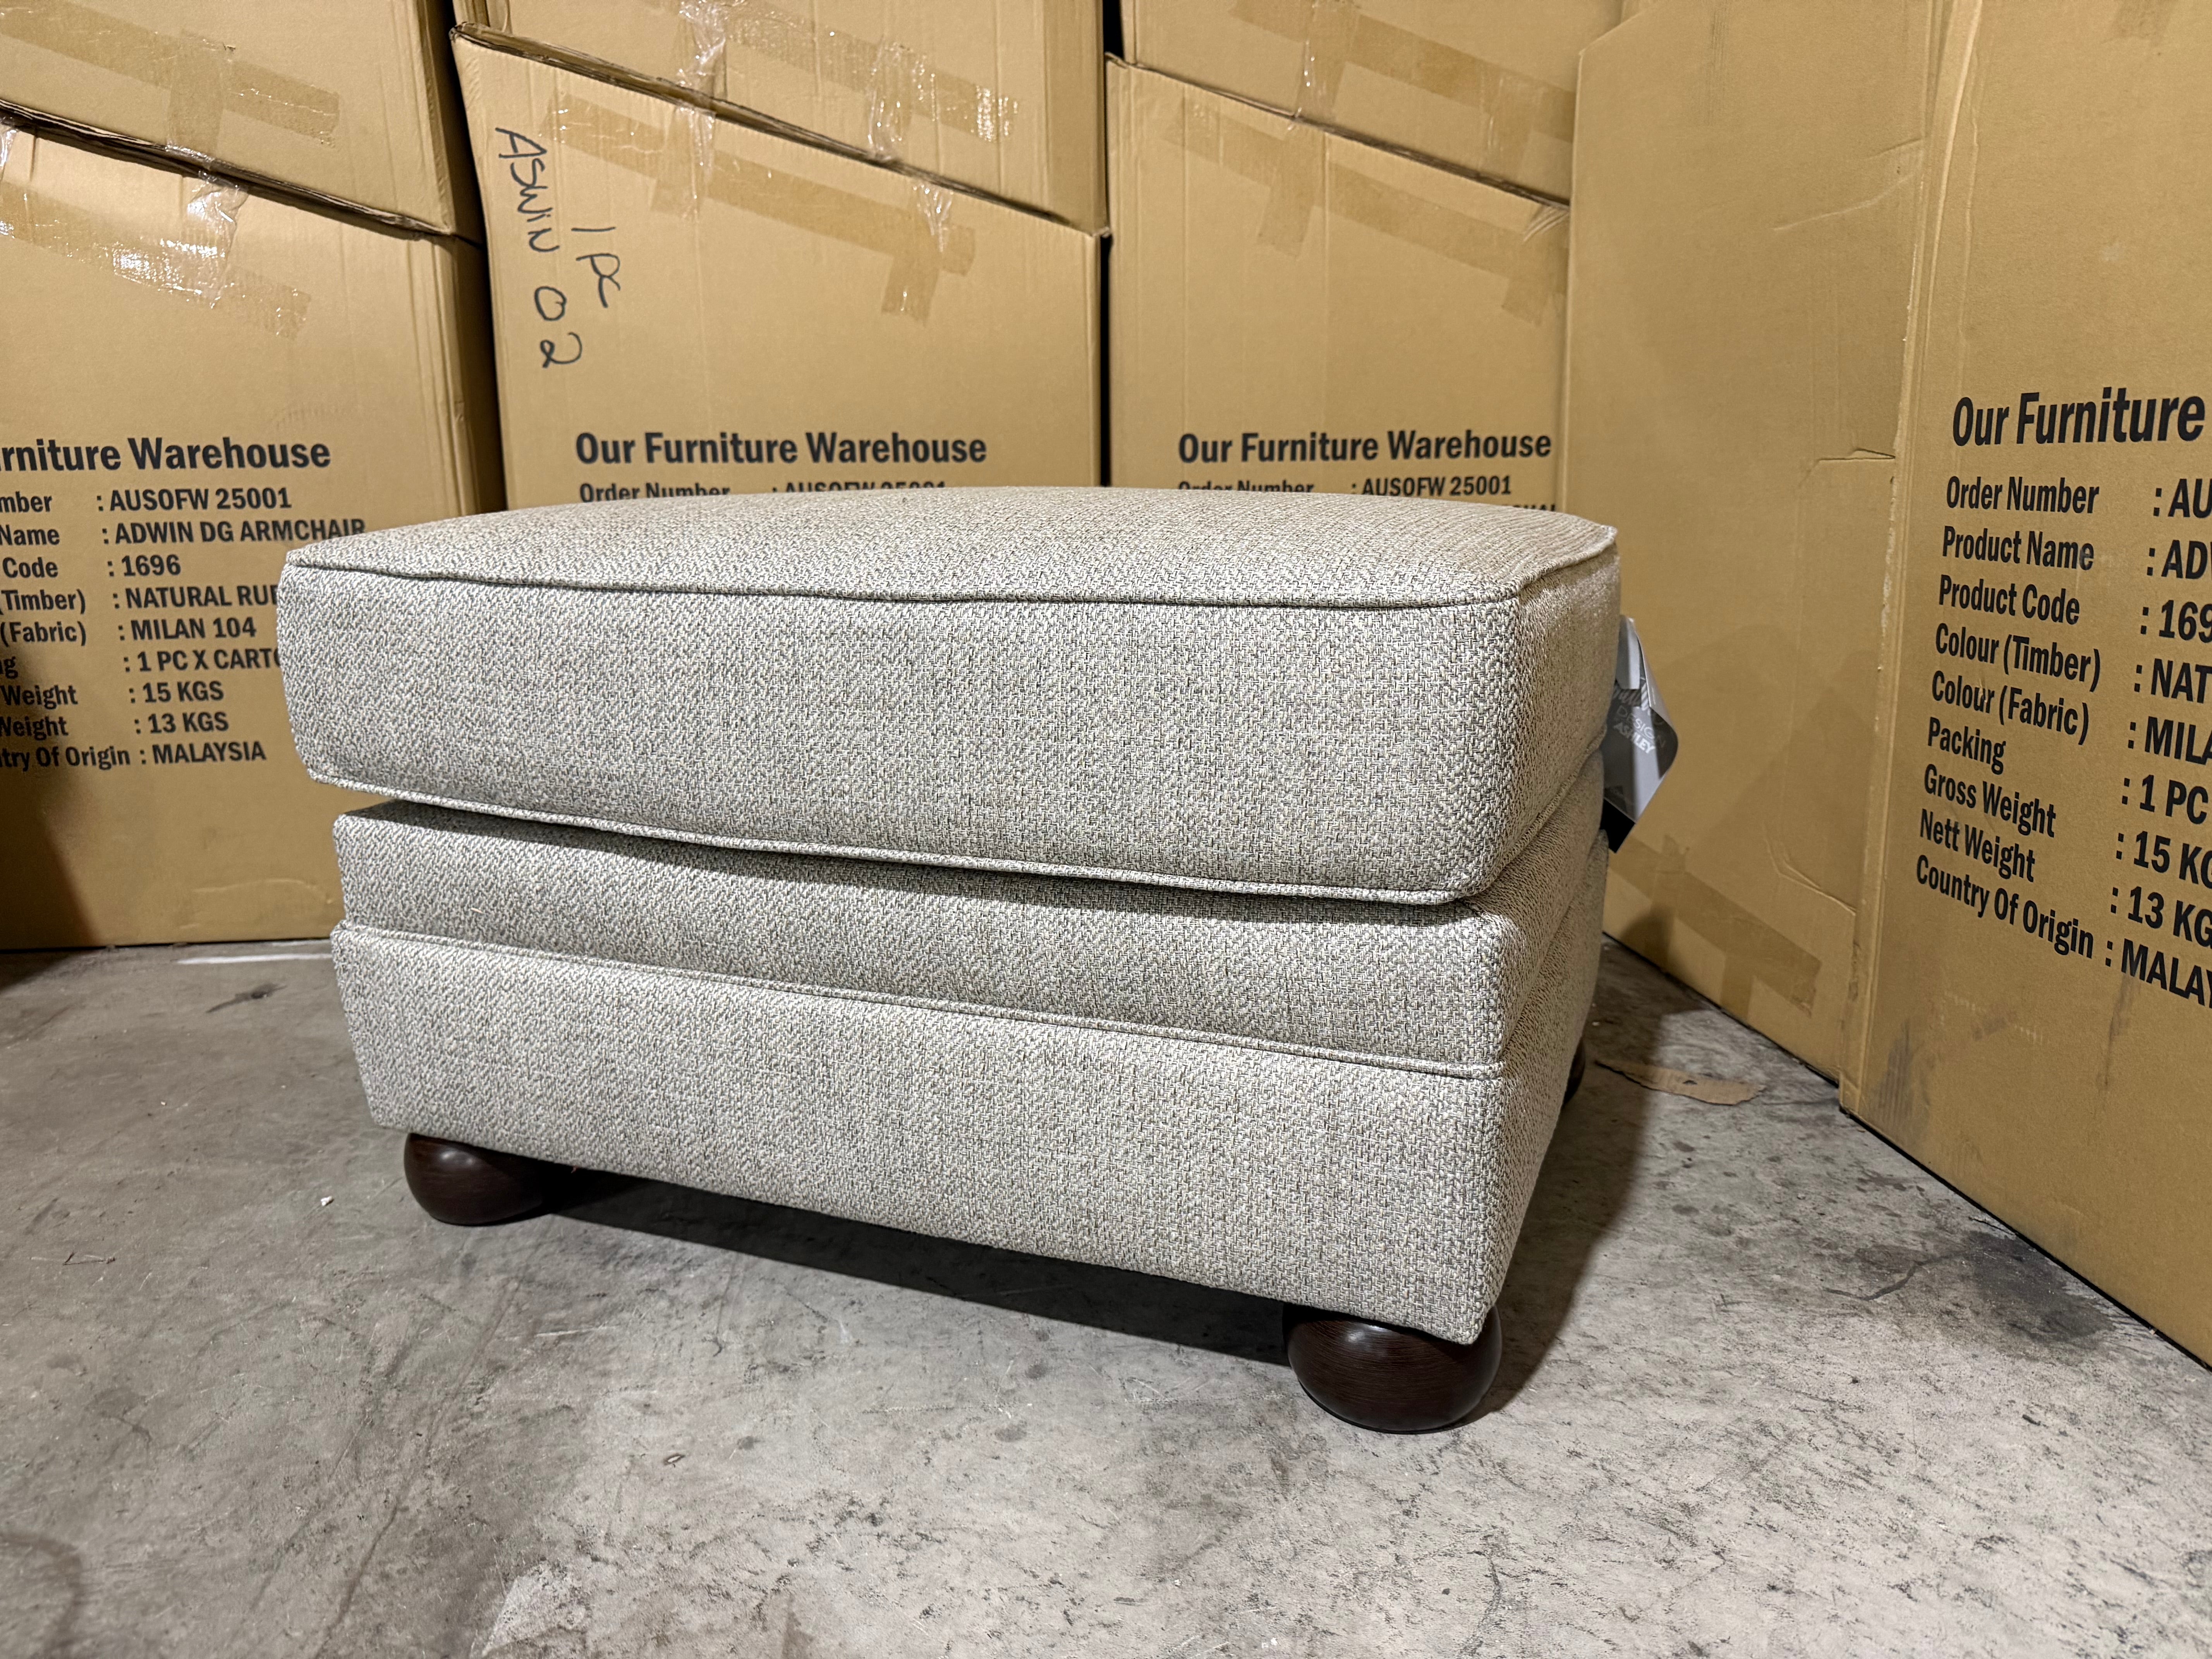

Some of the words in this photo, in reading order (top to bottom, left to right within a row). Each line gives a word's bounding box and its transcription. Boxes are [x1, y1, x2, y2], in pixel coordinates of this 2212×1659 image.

[1953, 397, 2009, 447] Our
[2016, 386, 2205, 444] Furniture
[0, 438, 121, 471] rniture
[127, 436, 331, 469] Warehouse
[576, 432, 635, 464] Our
[645, 432, 797, 464] Furniture
[805, 431, 986, 463] Warehouse
[1178, 433, 1232, 463] Our
[1242, 431, 1378, 462] Furniture
[1388, 429, 1551, 460] Warehouse
[110, 489, 209, 511] AUSOFW
[215, 487, 292, 509] 25001
[579, 483, 641, 503] Order
[1361, 477, 1446, 497] AUSOFW
[1449, 475, 1511, 496] 25001
[1946, 476, 2003, 510] Order
[2006, 476, 2100, 514] Number
[2167, 478, 2212, 519] AU
[0, 524, 60, 546] Name
[115, 522, 194, 544] ADWIN
[200, 521, 234, 542] DG
[240, 518, 366, 541] ARMCHAIR
[1942, 526, 2022, 564] Product
[2026, 531, 2094, 570] Name
[2, 556, 58, 578] Code
[121, 554, 181, 576] 1696
[0, 589, 86, 615] Timber)
[125, 586, 232, 608] NATURAL
[1939, 574, 2017, 616] Product
[2022, 584, 2080, 625] Code
[0, 621, 86, 648] (Fabric)
[131, 618, 205, 640] MILAN
[213, 617, 257, 638] 104
[137, 651, 151, 672] 1
[157, 650, 188, 671] PC
[192, 650, 209, 670] X
[1936, 623, 1999, 664] Colour
[2003, 634, 2100, 692] (Timber)
[0, 684, 78, 710] Weight
[143, 682, 171, 703] 15
[177, 680, 224, 702] KGS
[1932, 670, 1995, 714] Colour
[1999, 685, 2089, 745] (Fabric)
[148, 713, 176, 733] 13
[182, 711, 228, 732] KGS
[35, 745, 60, 768] Of
[65, 745, 131, 771] Origin
[152, 741, 266, 764] MALAYSIA
[1927, 716, 2006, 775] Packing
[2140, 774, 2155, 812] 1
[2165, 780, 2209, 824] PC
[1924, 764, 1977, 809] Gross
[1982, 781, 2056, 838] Weight
[2133, 831, 2171, 873] 15
[1920, 808, 1960, 852] Nett
[1965, 824, 2035, 883] Weight
[2128, 886, 2164, 929] 13
[1917, 854, 1990, 918] Country
[1994, 888, 2019, 926] Of
[2023, 900, 2094, 959] Origin
